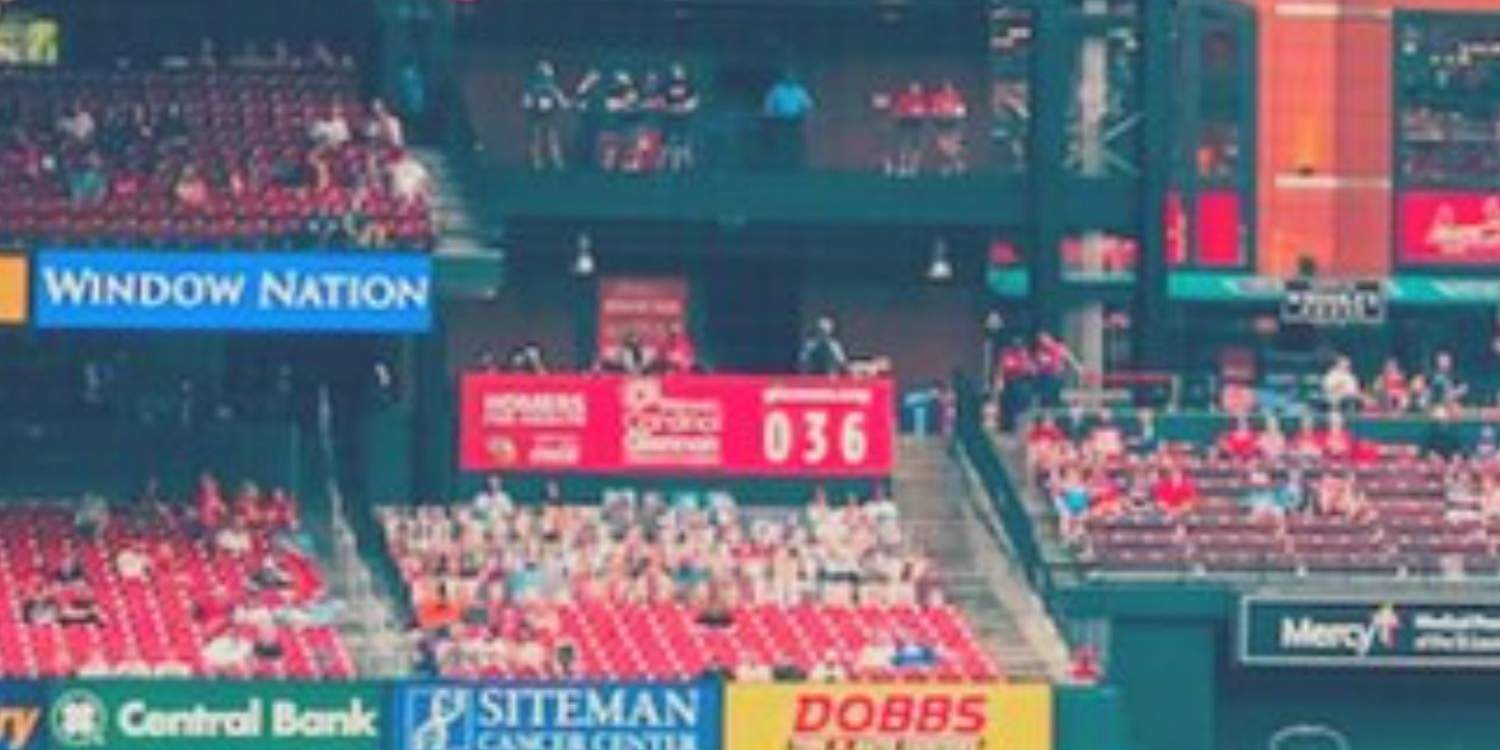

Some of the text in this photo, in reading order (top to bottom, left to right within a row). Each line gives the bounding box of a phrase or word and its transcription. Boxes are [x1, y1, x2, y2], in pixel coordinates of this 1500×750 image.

[43, 267, 428, 309] WINDOW NATION
[763, 411, 868, 463] 036
[1280, 616, 1377, 656] Mercy
[118, 700, 377, 738] Central Bank
[478, 689, 699, 728] SITEMAN
[794, 696, 988, 733] DOBBS
